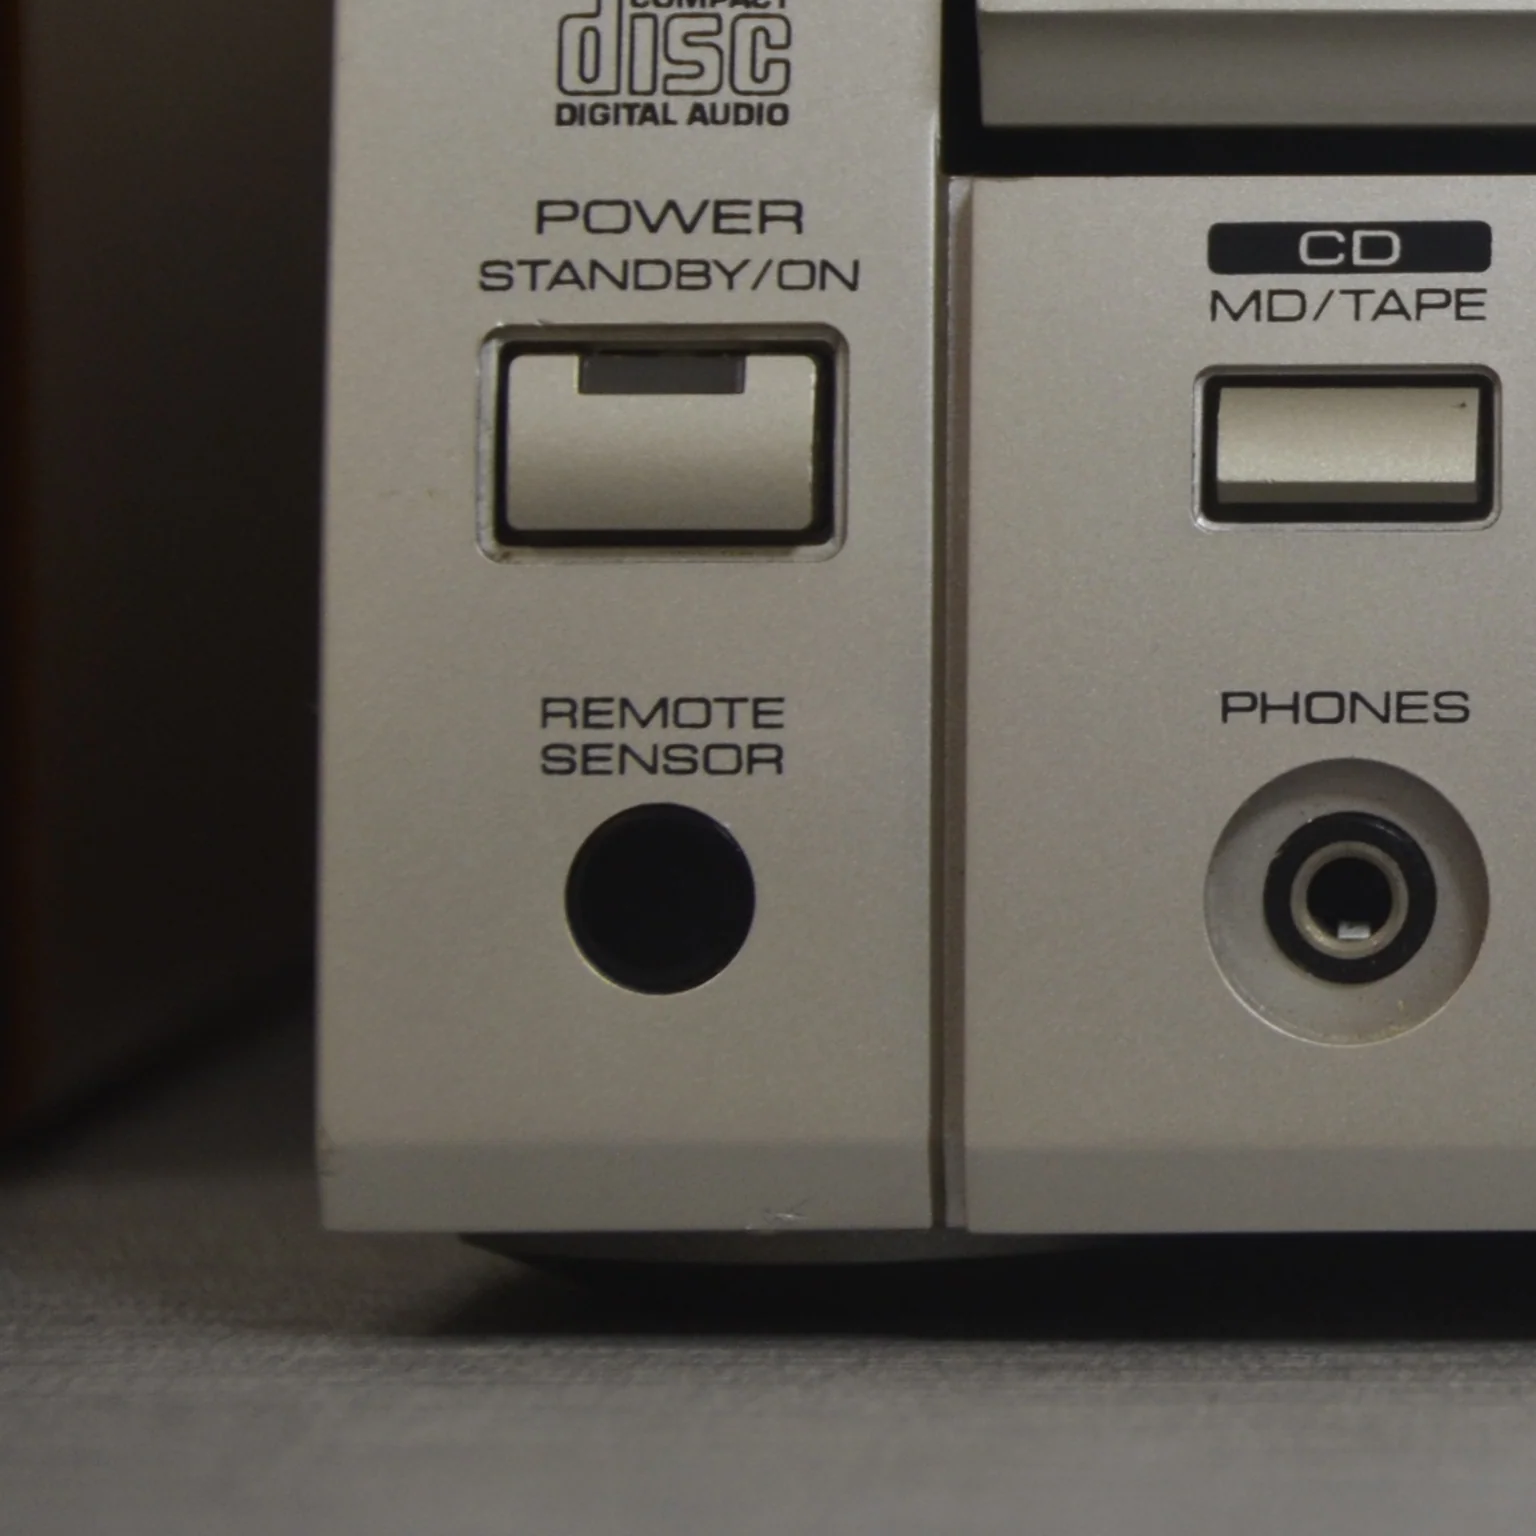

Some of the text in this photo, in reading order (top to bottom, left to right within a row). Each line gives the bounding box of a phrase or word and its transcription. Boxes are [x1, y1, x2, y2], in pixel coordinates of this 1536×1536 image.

[554, 101, 792, 128] DIGITAL AUDIO
[535, 198, 804, 236] POWER
[1297, 228, 1401, 267] CD
[478, 258, 860, 293] STANDBY/ON
[1209, 287, 1488, 323] MD/TAPE
[540, 696, 785, 730] REMOTE
[1220, 690, 1471, 725] PHONES
[540, 742, 784, 777] SENSOR
